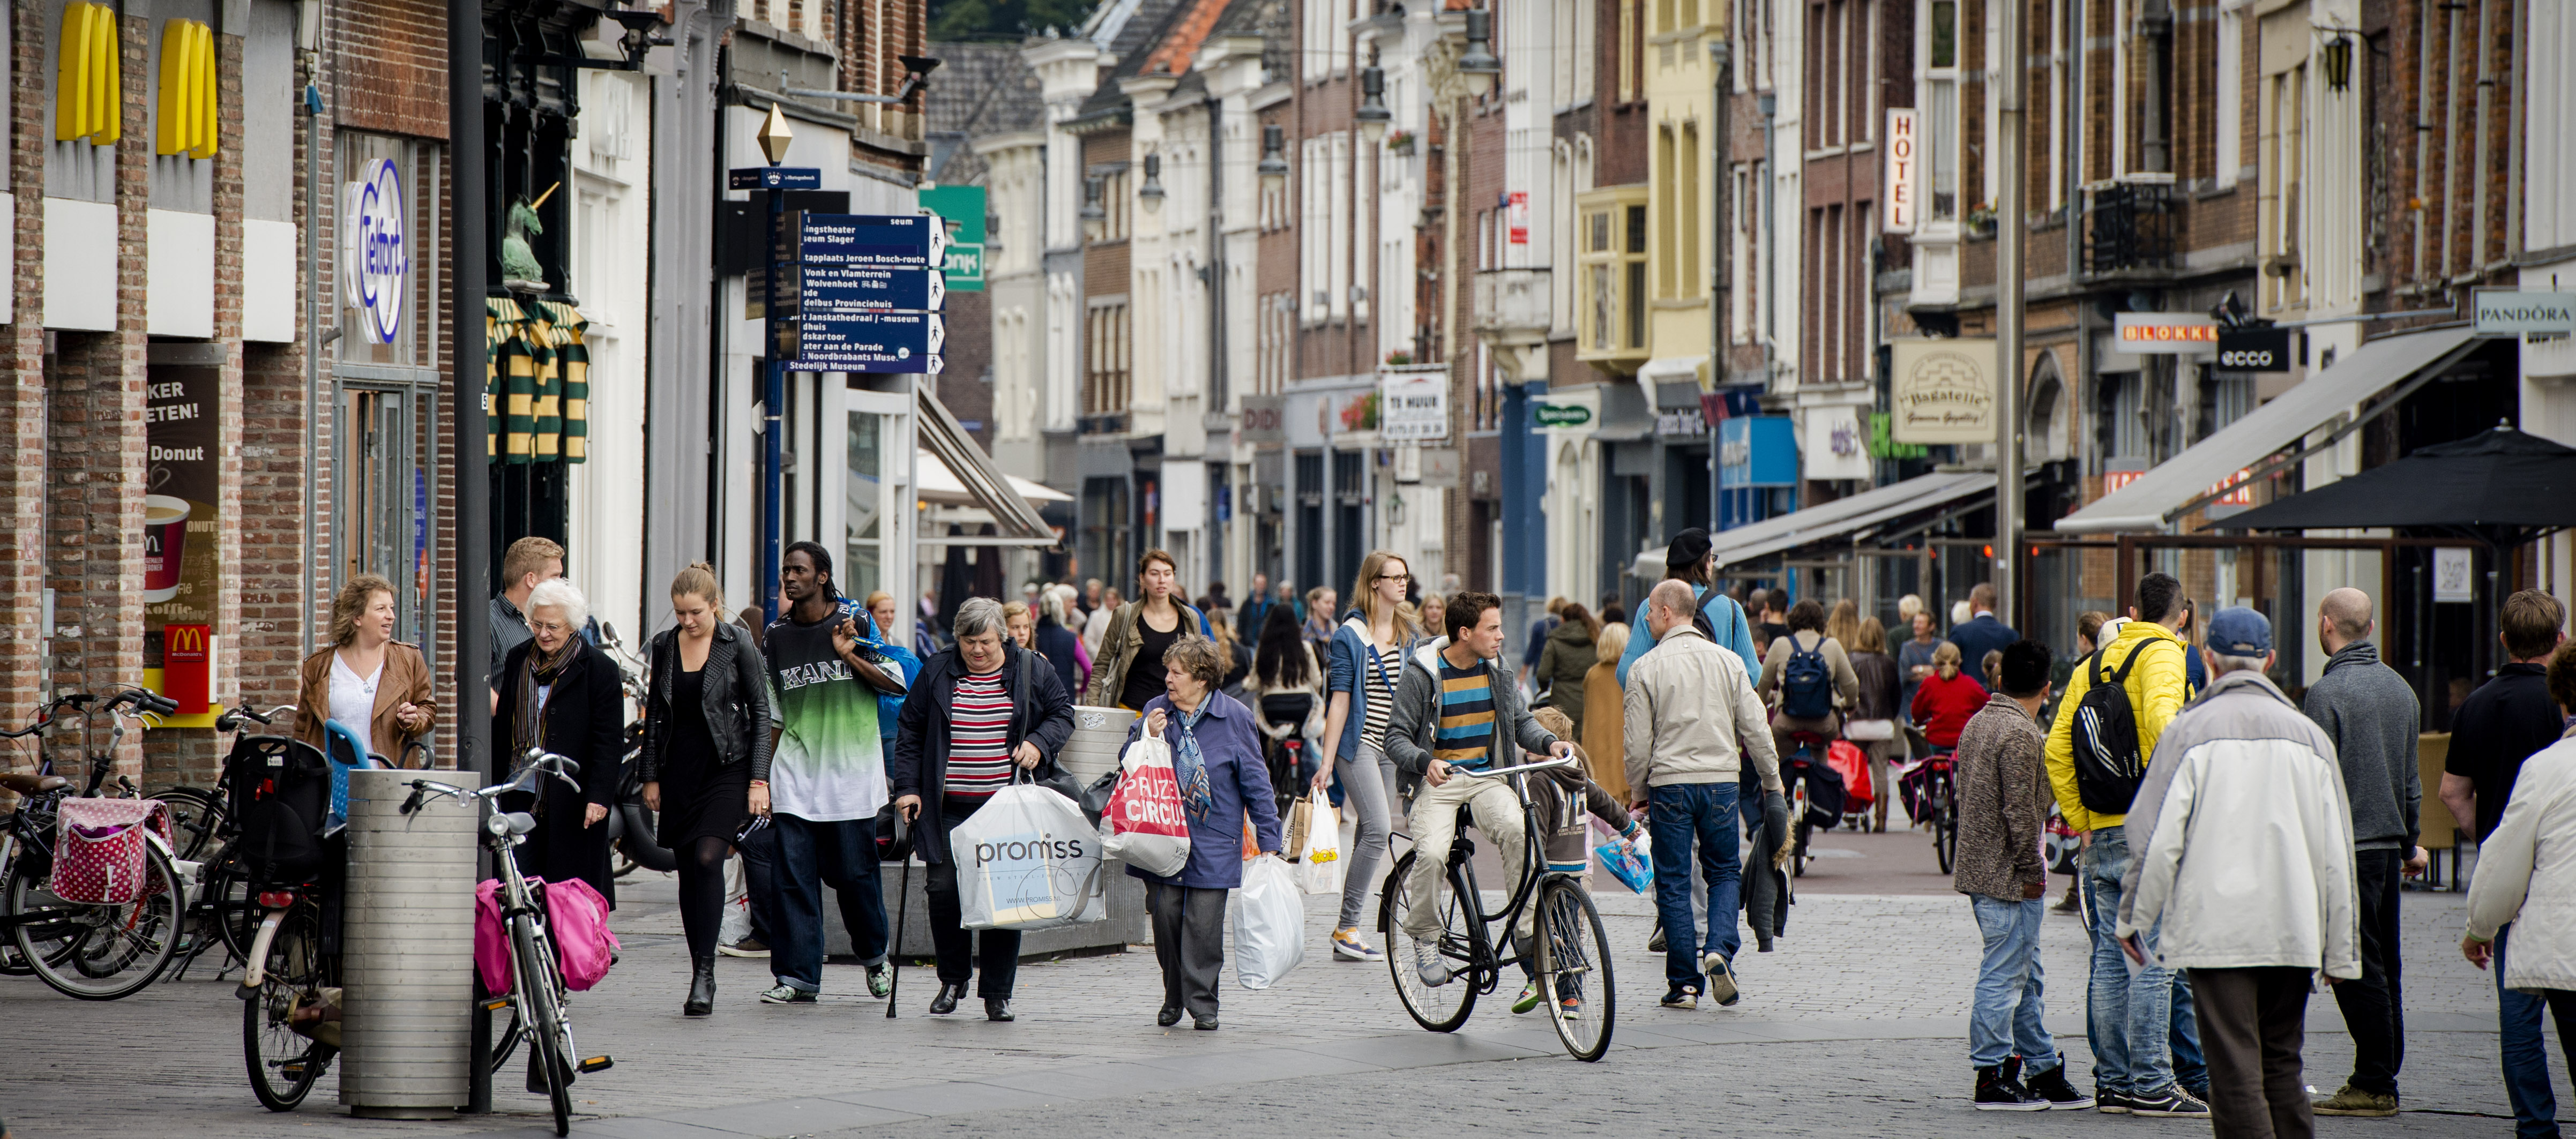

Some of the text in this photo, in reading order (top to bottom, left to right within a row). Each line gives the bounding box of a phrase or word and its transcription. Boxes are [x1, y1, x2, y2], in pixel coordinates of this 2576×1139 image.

[1894, 116, 1911, 226] HOTEL
[827, 235, 855, 245] Slager
[805, 254, 925, 264] tapplaats Jeroen Bosch-route
[841, 269, 891, 278] Vlamterrein
[806, 279, 858, 288] Wolvenhoek
[804, 298, 892, 309] delbus Provinciehuis
[808, 313, 872, 323] Janskathedraal
[803, 323, 826, 331] dhuis
[841, 343, 852, 351] de
[854, 343, 884, 351] Parade
[808, 353, 899, 362] Noordbrabants Muse
[2221, 350, 2273, 366] ecco
[790, 361, 865, 371] Stedelijk Museum
[147, 381, 185, 400] KER
[1390, 395, 1438, 409] TE HUUR
[146, 402, 199, 423] ETEN!
[151, 445, 204, 461] Donut
[975, 833, 1084, 868] promiss
[1006, 895, 1062, 905] WWW.PROMISS.NL
